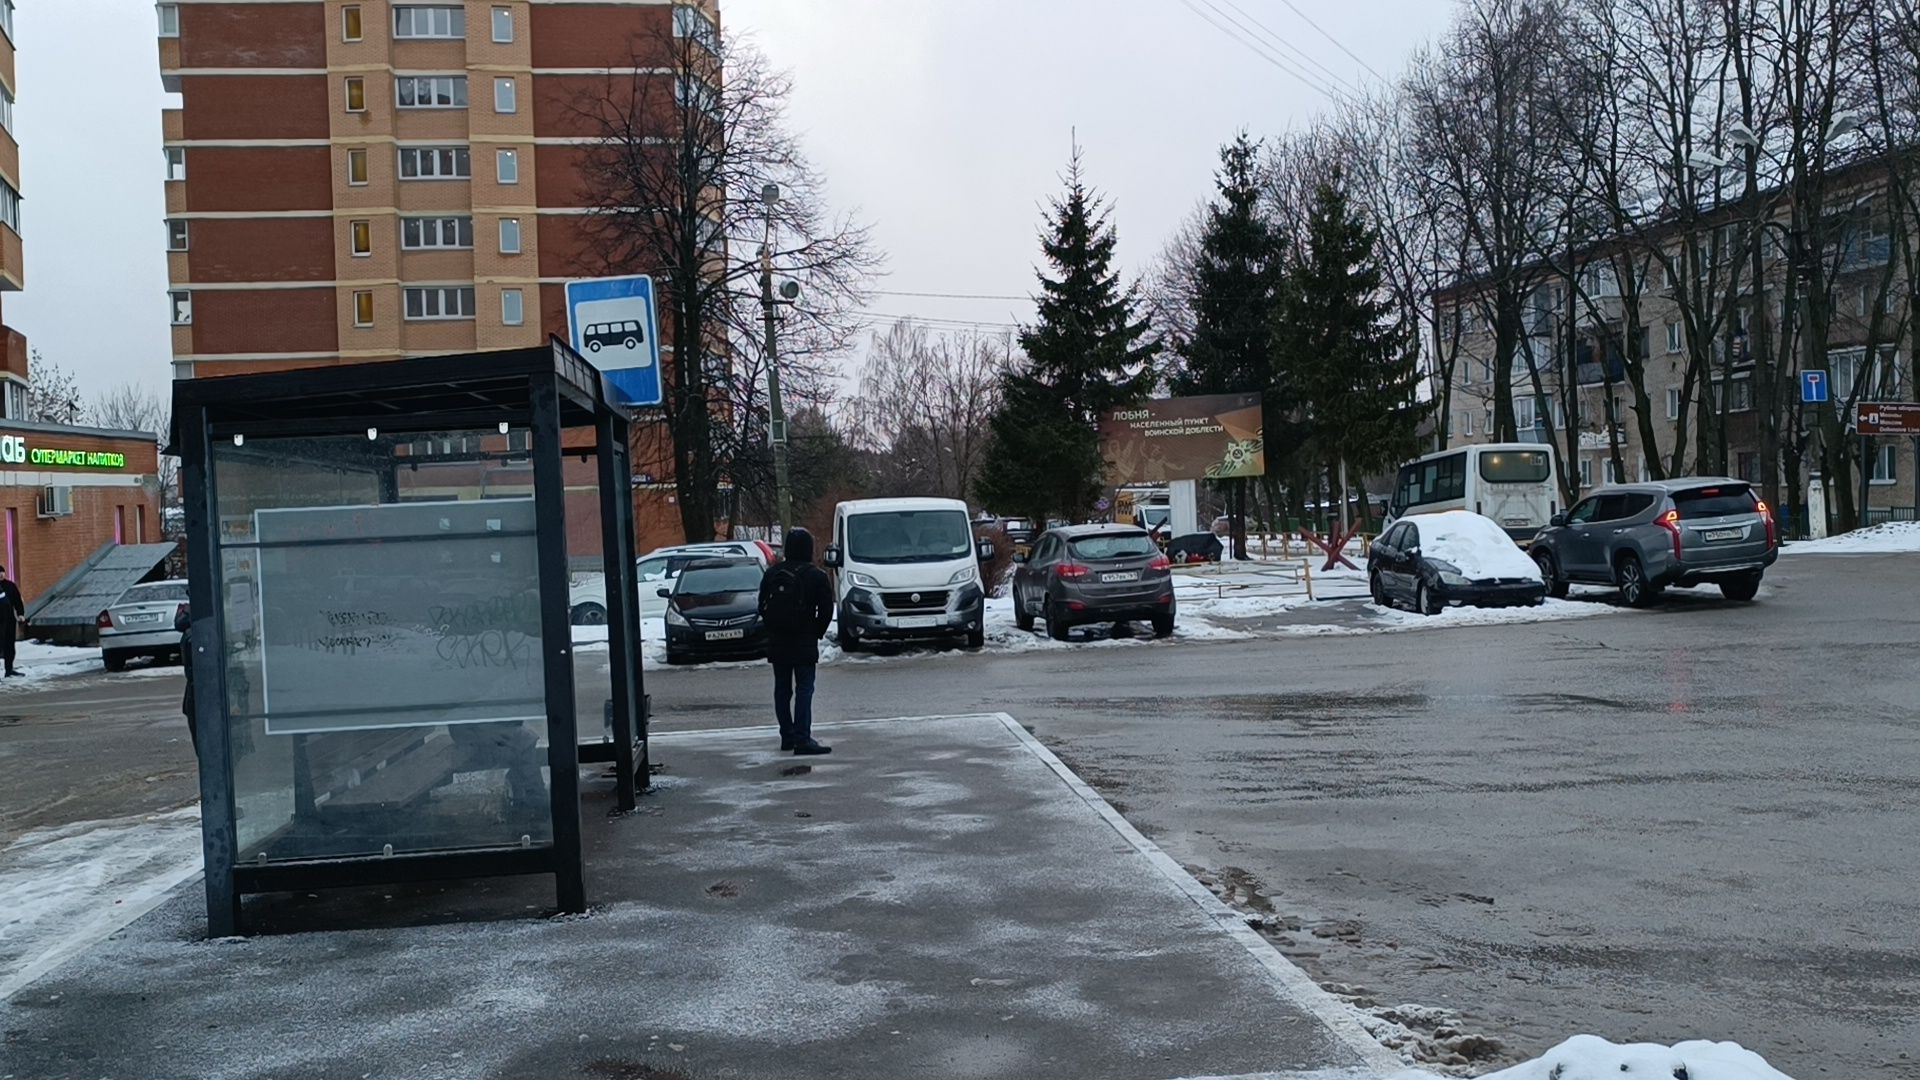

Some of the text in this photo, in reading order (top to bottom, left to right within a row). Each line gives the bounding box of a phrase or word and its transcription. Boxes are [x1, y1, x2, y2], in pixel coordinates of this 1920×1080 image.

[1112, 410, 1149, 421] ЛОБНЯ
[1130, 417, 1209, 429] НАСЕЛЕННЫЙ ПУНКТ
[1144, 425, 1224, 437] ВОИНСКОЙ ДОБЛЕСТИ
[31, 449, 124, 467] СУПЕРМАРКЕТ НАПИТКОВ
